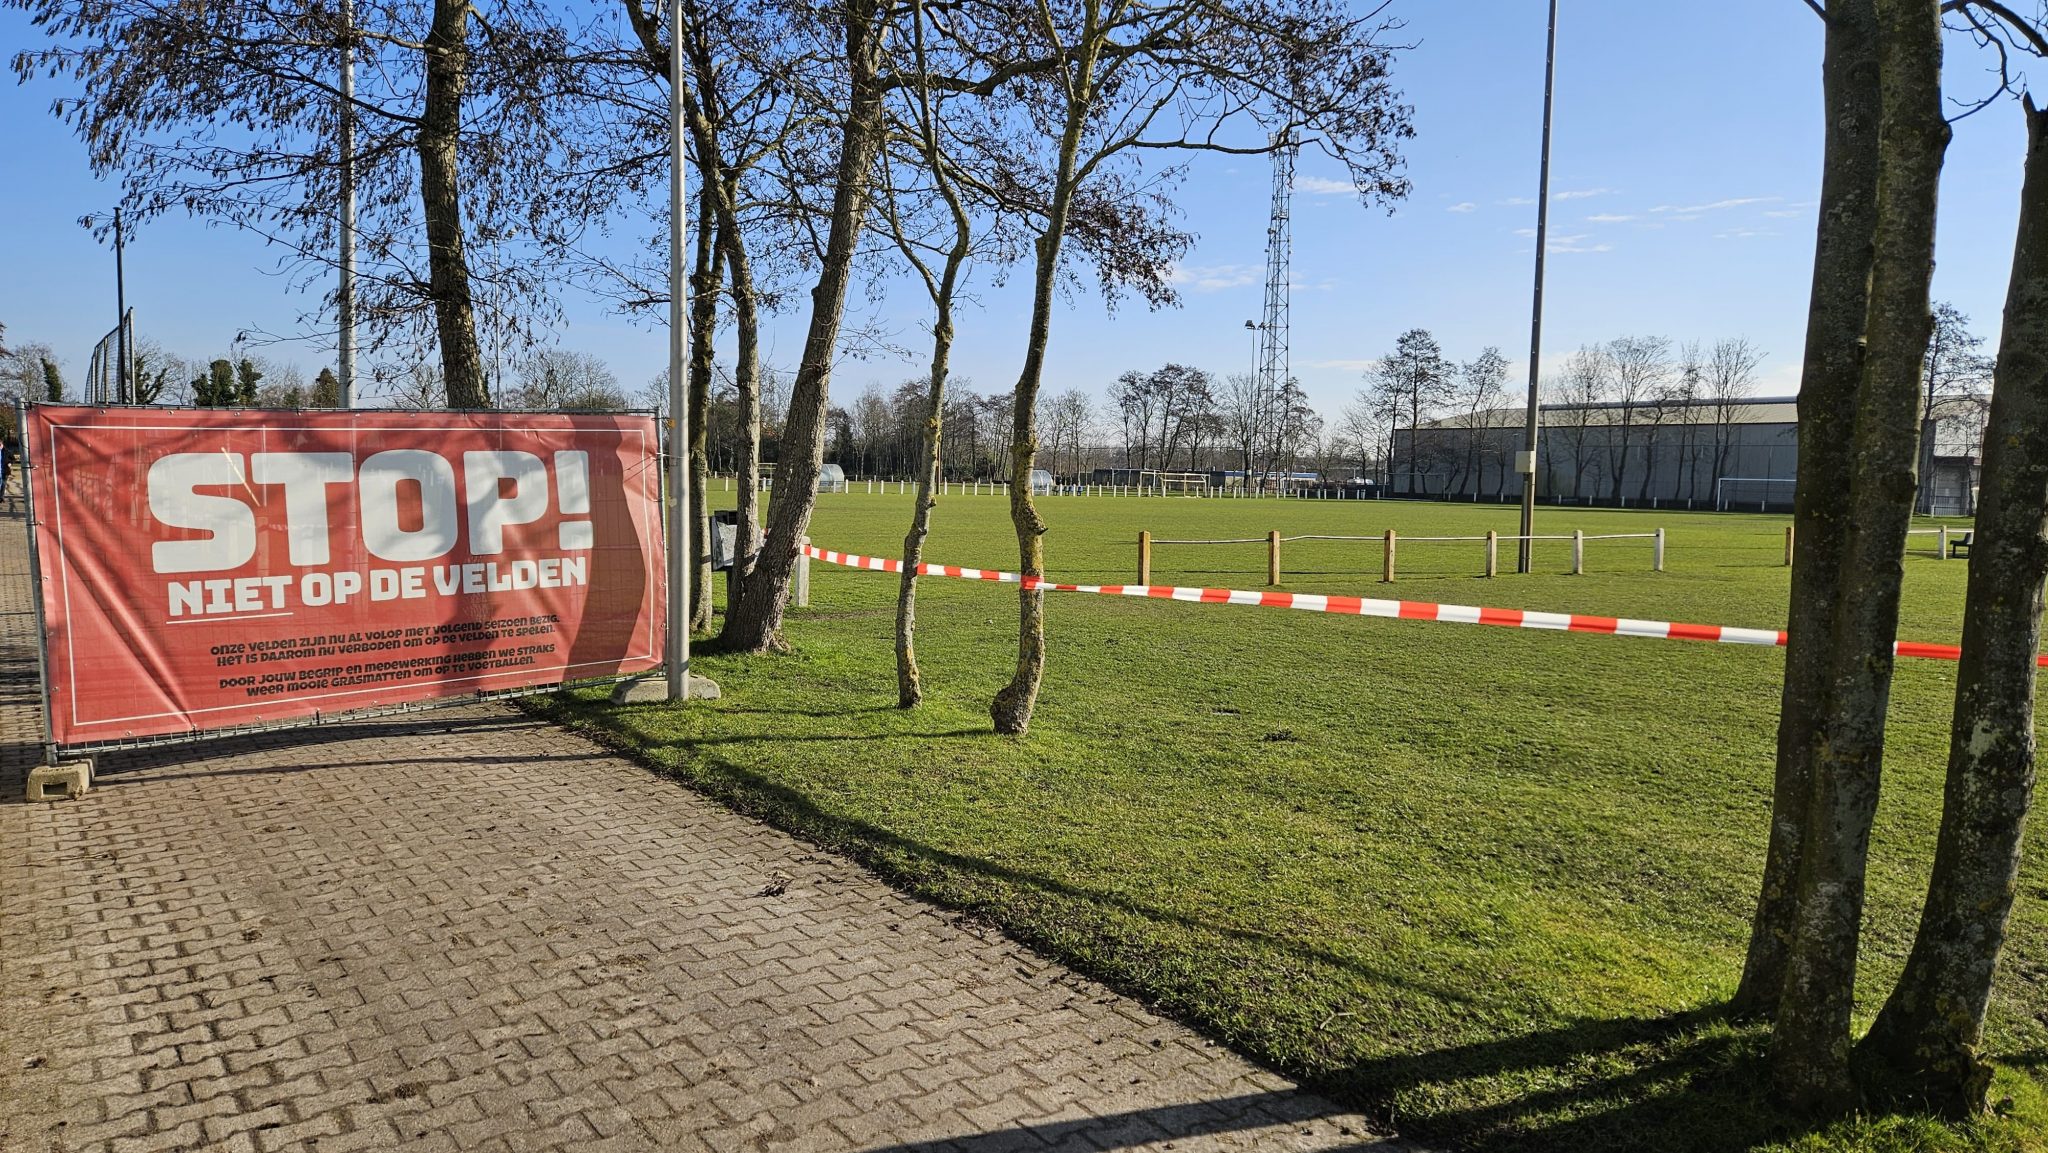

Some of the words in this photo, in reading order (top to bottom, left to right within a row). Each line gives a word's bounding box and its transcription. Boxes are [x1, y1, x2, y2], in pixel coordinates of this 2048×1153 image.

[147, 449, 594, 573] STOP!
[168, 575, 293, 616] NIET
[301, 571, 362, 607] OP
[369, 566, 427, 602] DE
[432, 556, 587, 596] VELDEN
[210, 643, 246, 656] ONZE
[248, 638, 297, 652] VELDEN
[299, 635, 327, 647] ZIJN
[328, 634, 346, 645] NU
[348, 632, 363, 643] AL
[365, 629, 403, 641] VOLOP
[405, 626, 430, 638] MET
[433, 621, 483, 635] VOLGEND
[484, 617, 528, 630] SEIZOEN
[529, 614, 560, 626] BEZIG.
[217, 654, 243, 667] HET
[246, 653, 258, 664] IS
[260, 649, 316, 662] DAAROM
[318, 646, 336, 657] NU
[338, 639, 401, 655] VERBODEN
[403, 637, 423, 648] OM
[425, 635, 440, 646] OP
[442, 633, 457, 644] DE
[459, 630, 500, 643] VELDEN
[501, 627, 514, 638] TE
[515, 624, 556, 637] SPELEN.
[219, 675, 256, 689] DOOR
[258, 671, 297, 685] JOUW
[298, 666, 344, 680] BEGRIP
[345, 664, 363, 675] EN
[364, 654, 451, 674] MEDEWERKING
[453, 650, 497, 663] HEBBEN
[498, 647, 516, 658] WE
[516, 643, 555, 656] STRAKS
[246, 683, 285, 697] WEER
[286, 678, 329, 692] MOOIE
[330, 669, 412, 688] GRASMATTEN
[413, 666, 437, 677] OM
[436, 665, 450, 675] OP
[451, 663, 466, 674] TE
[467, 656, 536, 671] VOETBALLEN.
